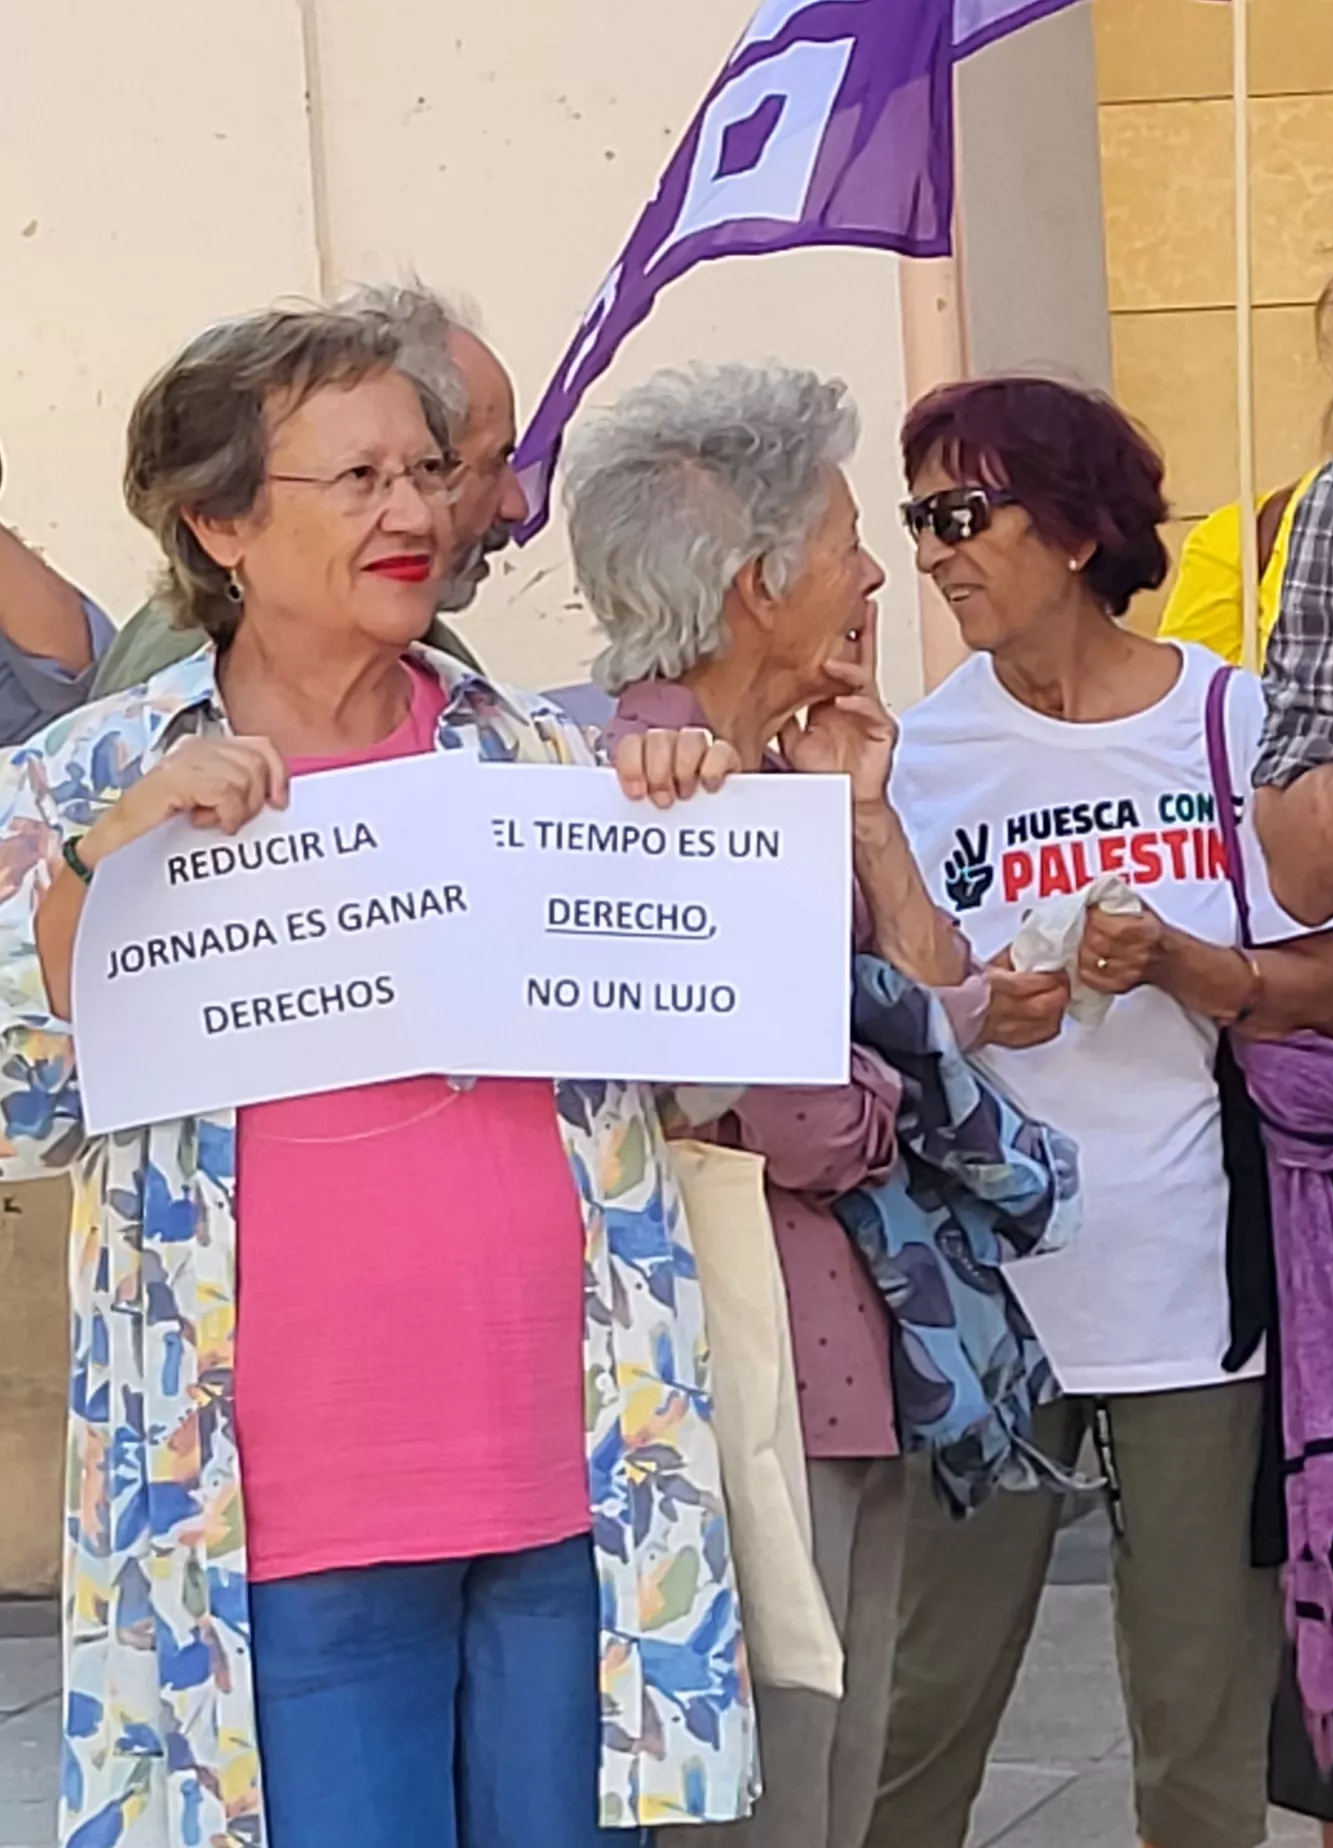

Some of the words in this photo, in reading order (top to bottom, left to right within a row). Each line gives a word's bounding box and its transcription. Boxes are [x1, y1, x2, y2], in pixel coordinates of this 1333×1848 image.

[533, 820, 667, 856] TIEMPO
[678, 828, 716, 858] ES
[728, 829, 780, 858] UN
[1006, 798, 1141, 847] HUESCA
[1157, 792, 1216, 825] CON
[166, 831, 326, 887] REDUCIR
[332, 822, 378, 855] LA
[106, 917, 278, 981] JORNADA
[286, 908, 328, 942] ES
[337, 884, 468, 933] GANAR
[545, 897, 717, 941] DERECHO,
[202, 975, 396, 1036] DERECHOS
[527, 978, 581, 1008] NO
[592, 980, 642, 1011] UN
[654, 982, 736, 1014] LUJO
